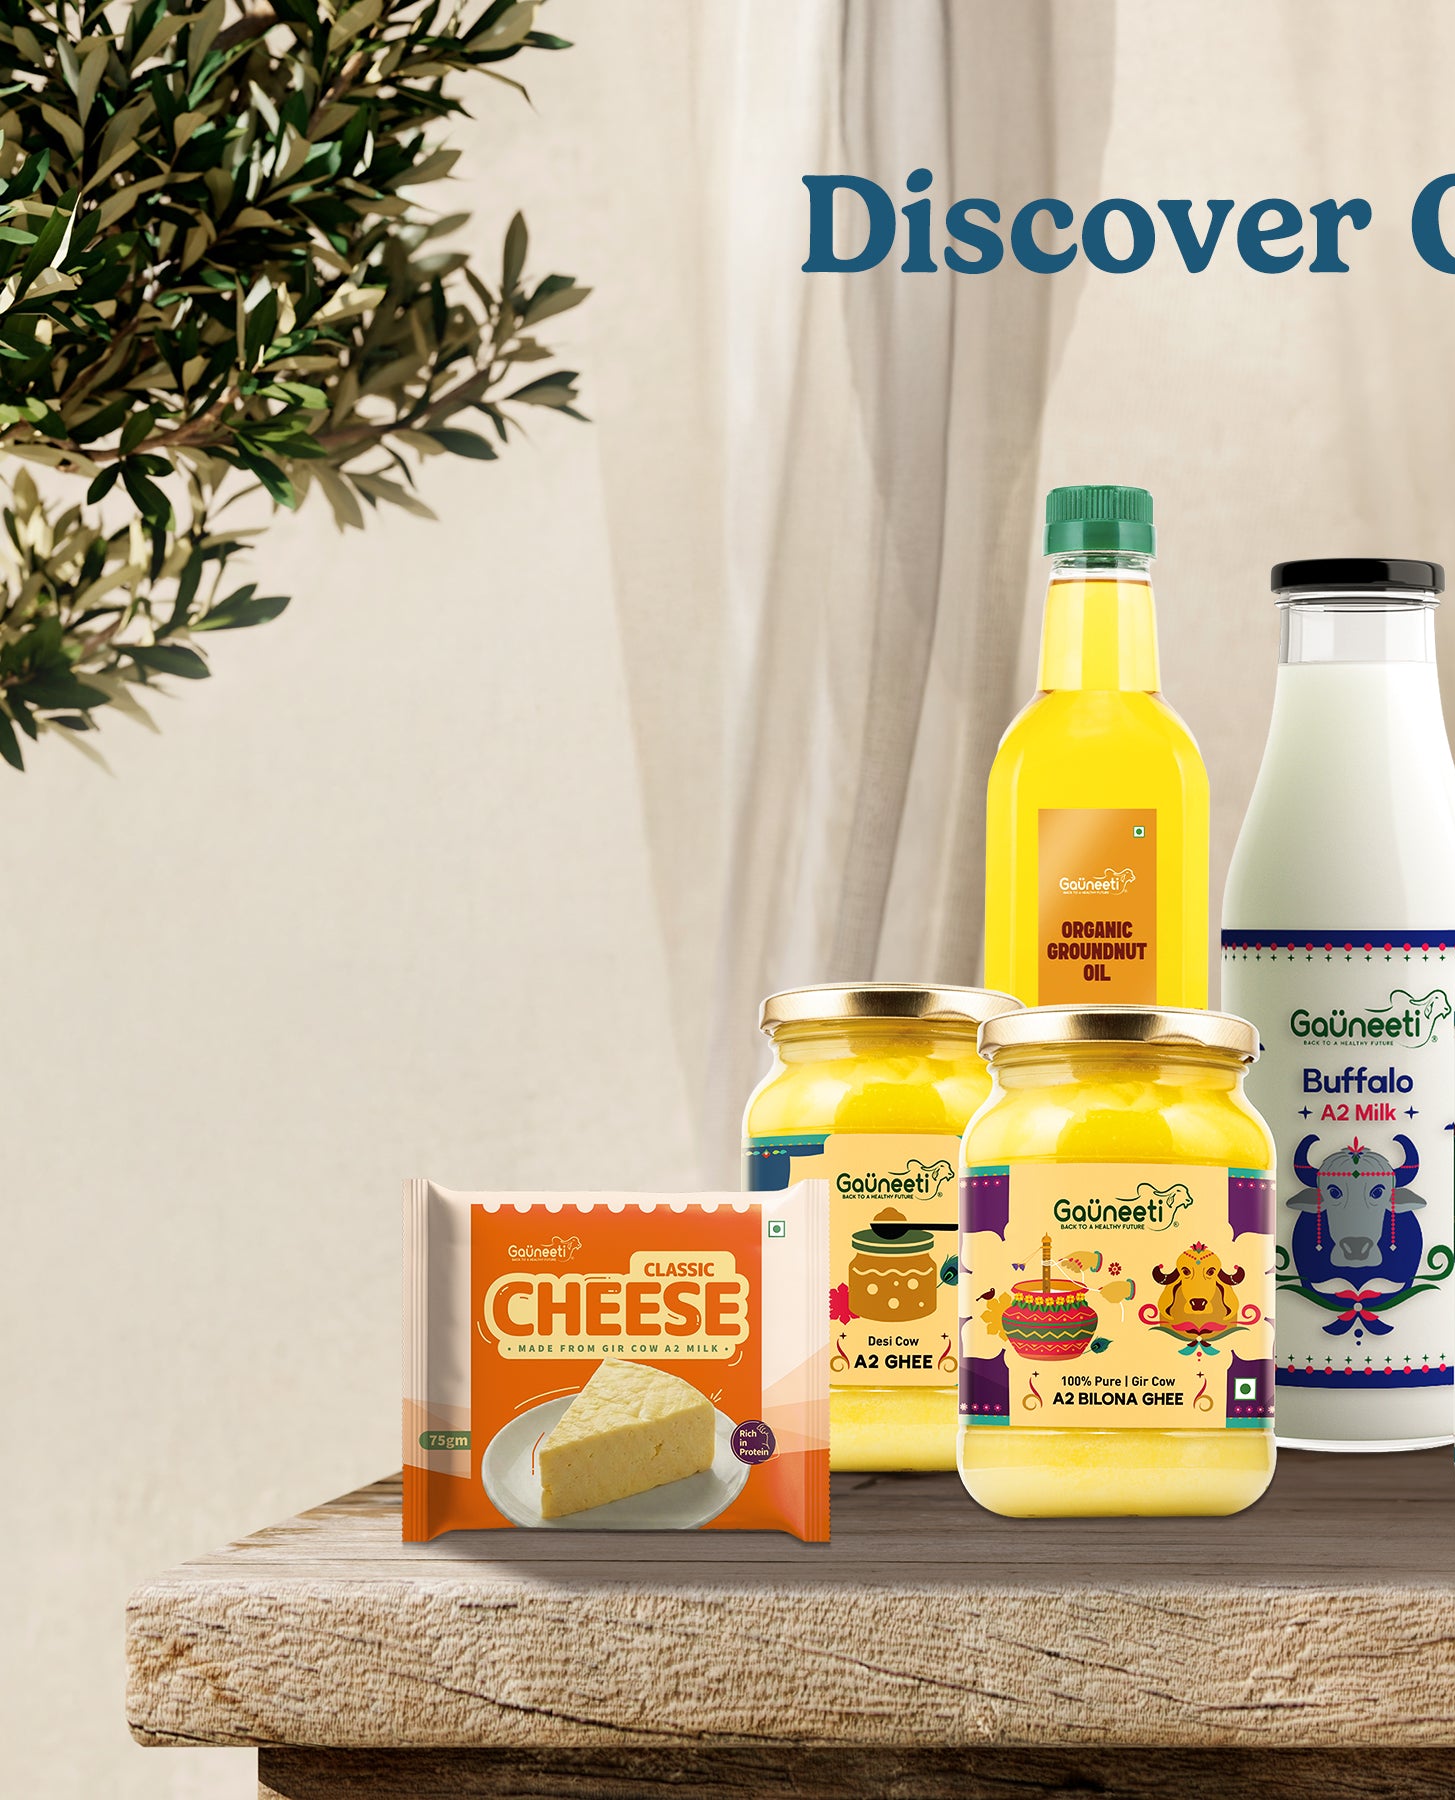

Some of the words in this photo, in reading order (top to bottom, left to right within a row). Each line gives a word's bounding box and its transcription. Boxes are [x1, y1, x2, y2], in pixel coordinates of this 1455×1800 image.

[1059, 877, 1119, 890] Gaüneeti
[1061, 921, 1133, 938] ORGANIC
[1047, 942, 1147, 960] GROUNDNUT
[1083, 964, 1111, 981] OIL
[1290, 1009, 1421, 1038] Gaüneeti
[1303, 1066, 1414, 1094] Buffalo
[1320, 1104, 1349, 1121] A2
[1355, 1103, 1397, 1121] Milk
[836, 1172, 929, 1193] Gaüneeti
[1053, 1198, 1163, 1223] Gaüneeti
[507, 1245, 566, 1258] Gaüneeti
[643, 1262, 715, 1277] CLASSIC
[492, 1281, 741, 1337] CHEESE
[518, 1344, 553, 1353] MADE
[560, 1344, 596, 1353] FROM
[602, 1344, 625, 1353] GIR
[631, 1344, 659, 1353] COW
[664, 1344, 680, 1353] A2
[686, 1344, 719, 1353] MILK
[868, 1336, 892, 1346] Desi
[895, 1336, 920, 1346] Cow
[854, 1354, 879, 1369] A2
[885, 1354, 933, 1369] GHEE
[1061, 1376, 1092, 1387] 100%
[1094, 1376, 1122, 1387] Pure
[1131, 1376, 1149, 1387] Gir
[1151, 1376, 1176, 1387] Cow
[1053, 1391, 1075, 1405] A2
[1078, 1391, 1138, 1405] BILONA
[1142, 1391, 1184, 1405] GHEE
[429, 1434, 468, 1449] 75gm
[739, 1430, 757, 1438] Rich
[739, 1438, 748, 1447] in
[739, 1447, 769, 1456] Protein
